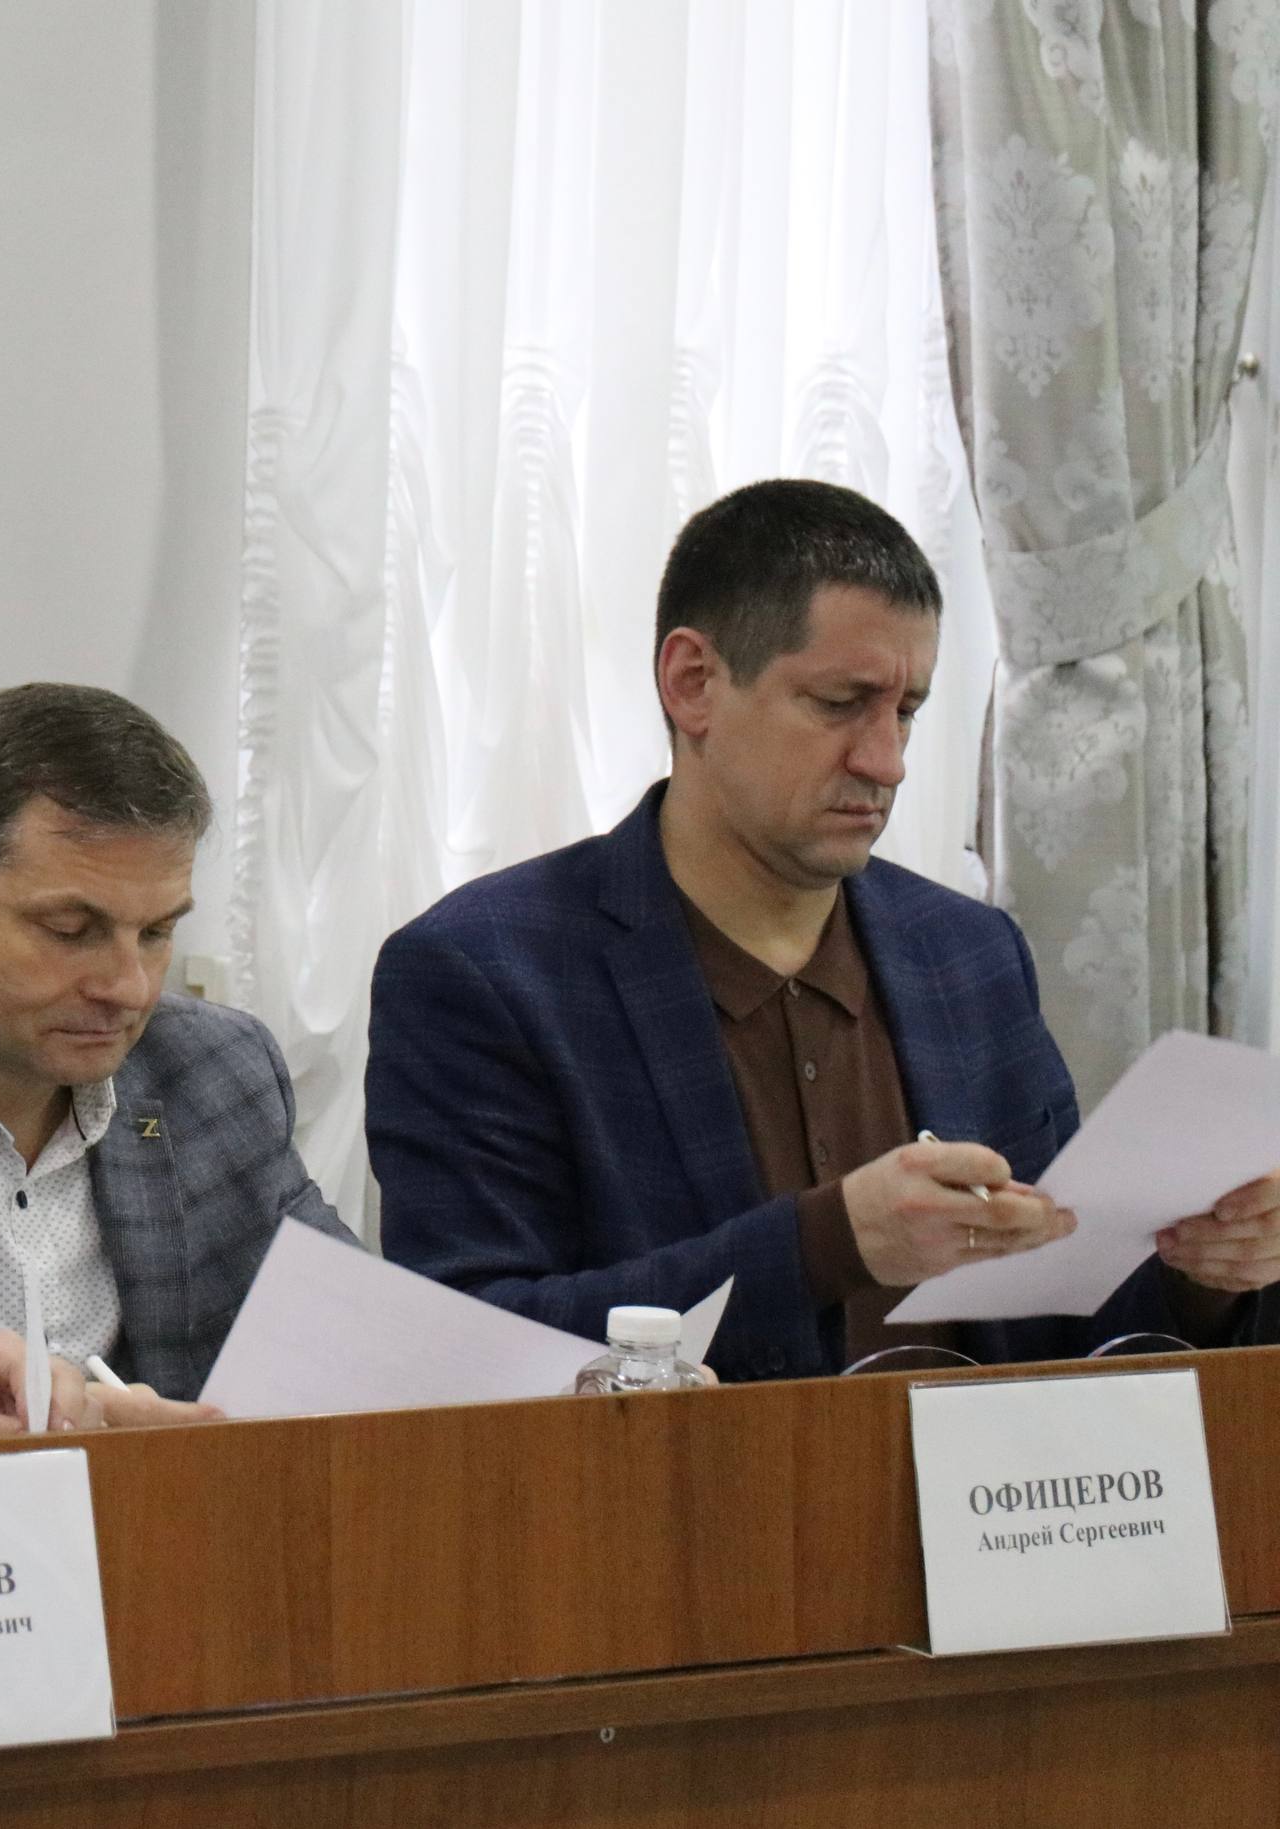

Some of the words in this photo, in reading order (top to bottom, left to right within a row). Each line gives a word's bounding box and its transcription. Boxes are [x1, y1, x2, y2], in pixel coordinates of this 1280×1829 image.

[139, 1118, 160, 1137] Z
[969, 1469, 1164, 1515] ОФИЦЕРОВ
[978, 1524, 1053, 1553] Андрей
[1059, 1518, 1165, 1547] Сергеевич
